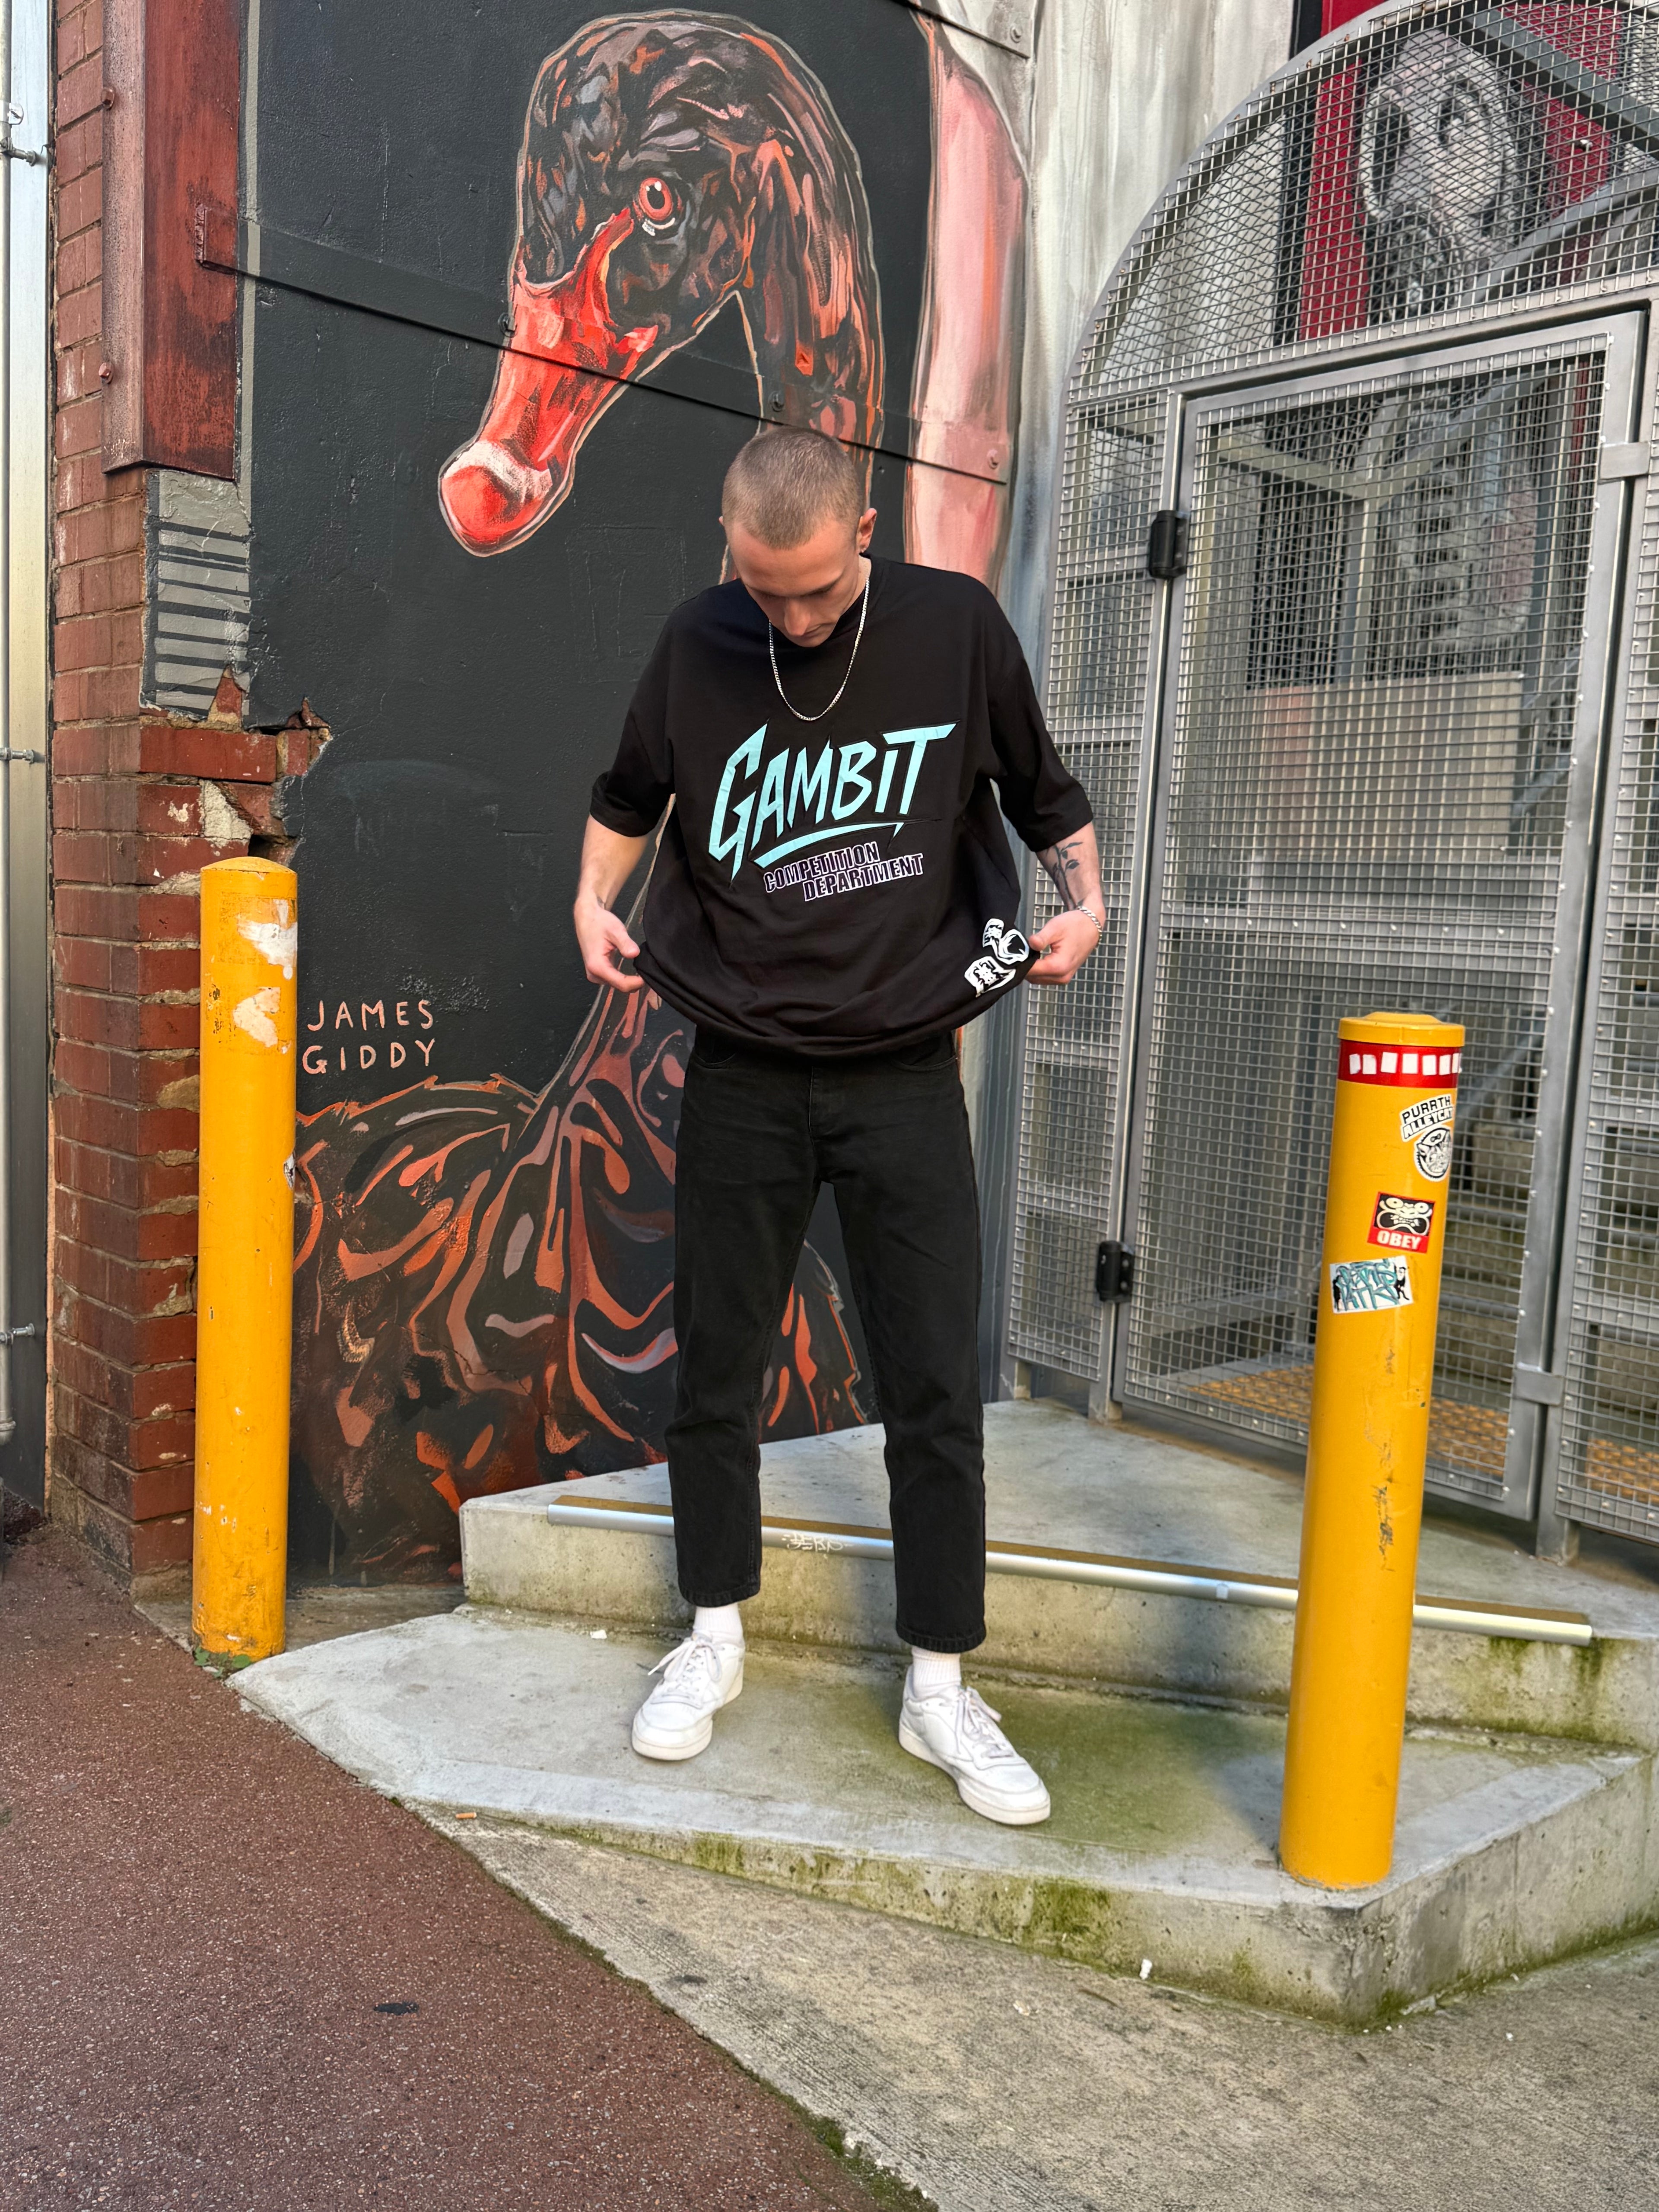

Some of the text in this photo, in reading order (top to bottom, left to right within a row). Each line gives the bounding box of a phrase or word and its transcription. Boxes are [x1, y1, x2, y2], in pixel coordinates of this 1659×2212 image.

[709, 723, 957, 881] GAMBIT
[763, 841, 880, 893] COMPETITION
[802, 853, 924, 902] DEPARTMENT
[307, 999, 433, 1031] JAMES
[302, 1038, 435, 1074] GIDDY
[1402, 1096, 1451, 1124] PURRTH
[1377, 1230, 1422, 1250] OBEY
